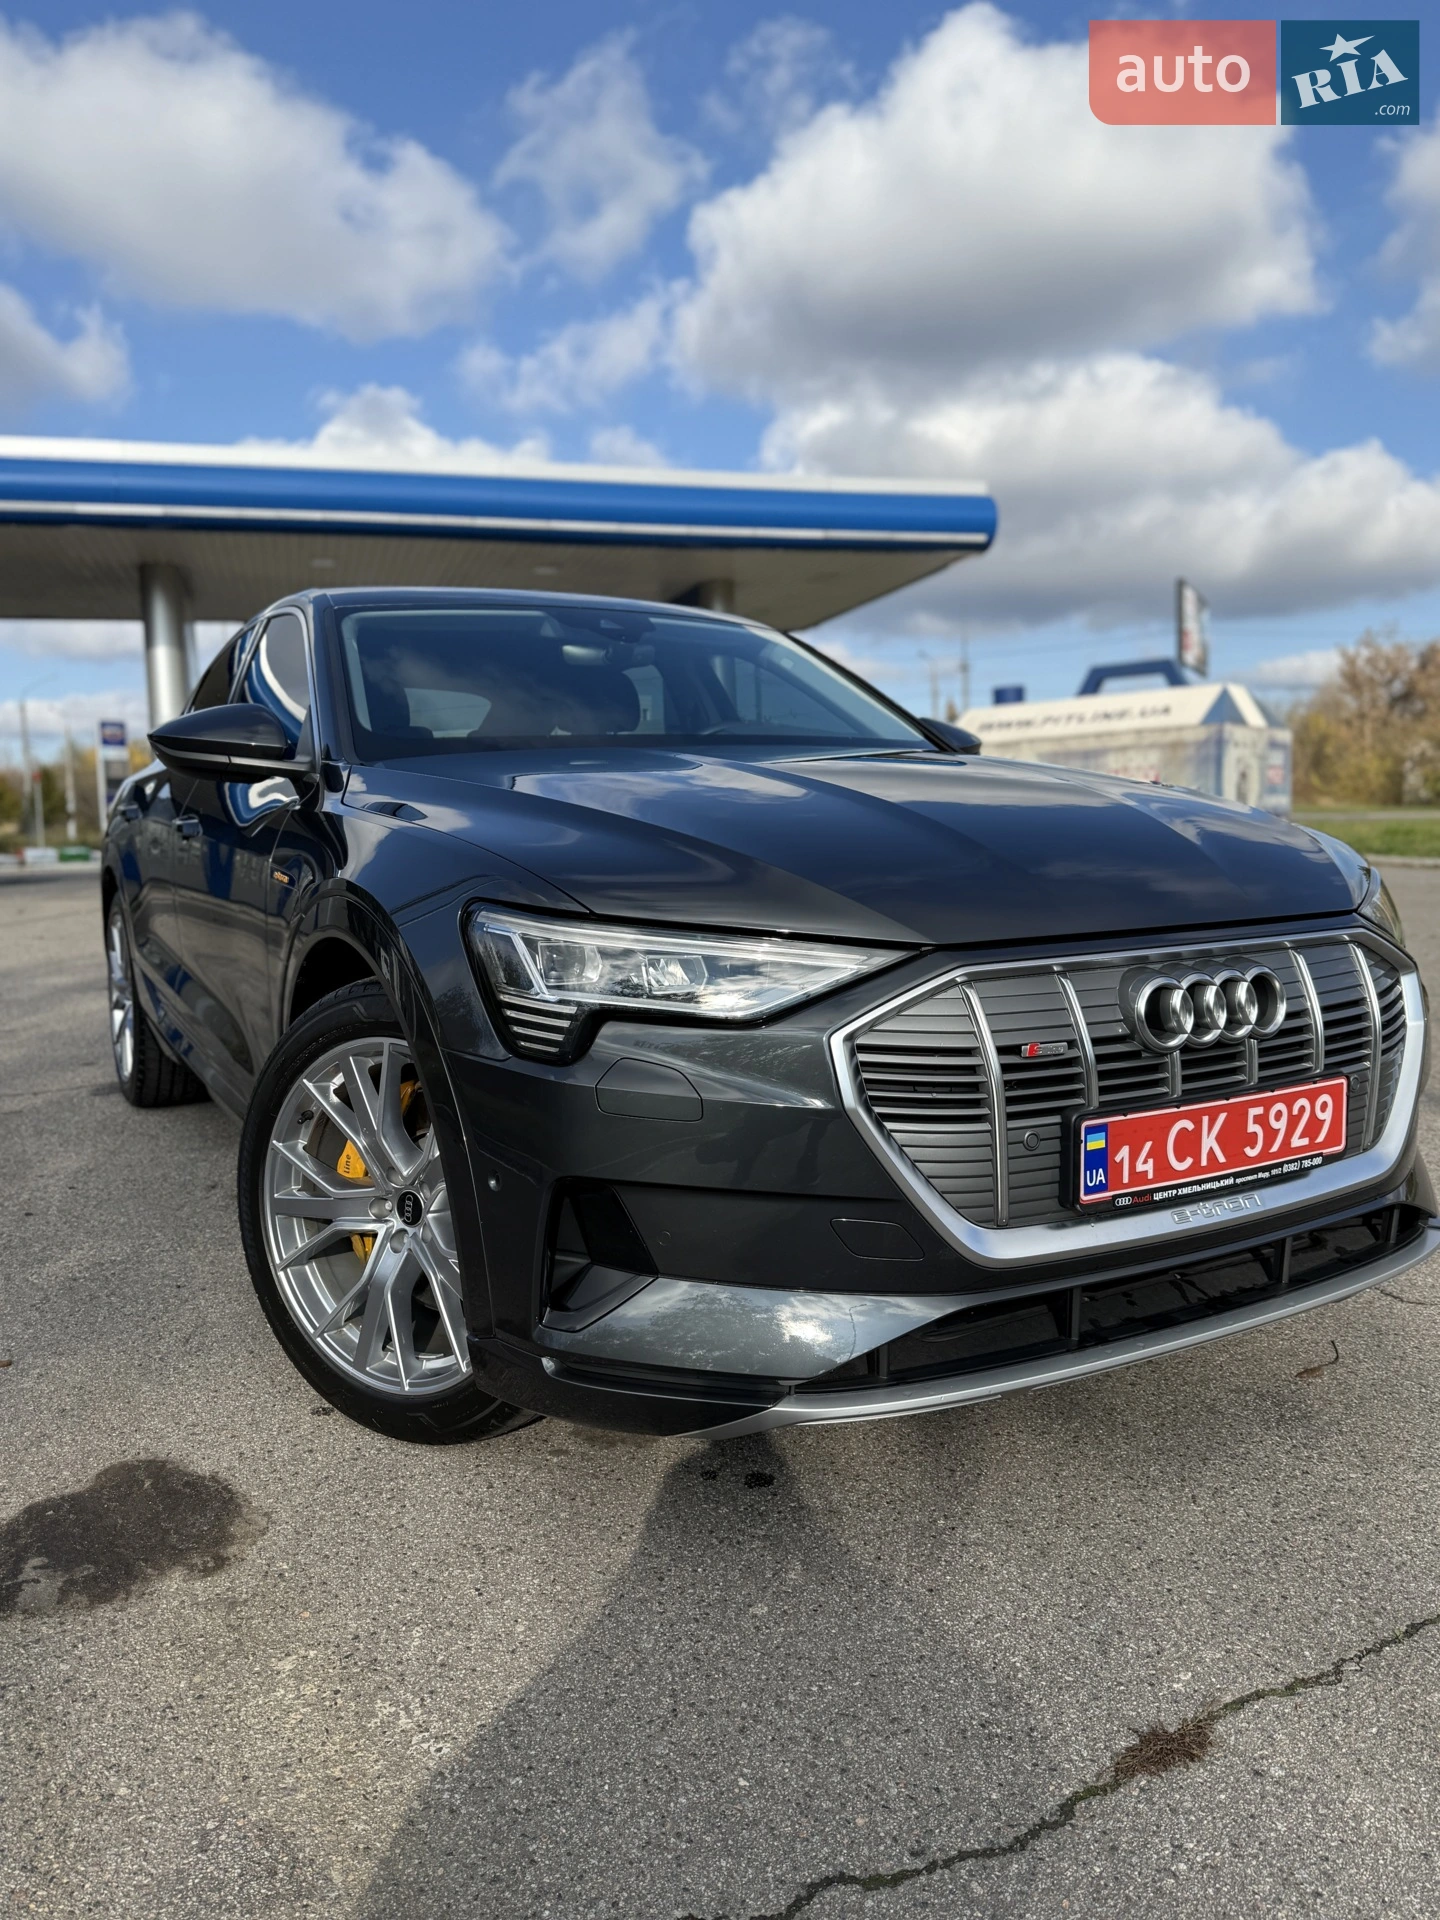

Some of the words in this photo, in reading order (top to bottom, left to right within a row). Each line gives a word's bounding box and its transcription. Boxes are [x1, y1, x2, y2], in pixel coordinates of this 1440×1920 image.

[1114, 1140, 1154, 1184] 14
[1166, 1112, 1228, 1171] CK
[1243, 1093, 1333, 1158] 5929
[1086, 1167, 1106, 1187] UA
[1132, 1193, 1152, 1204] Audi
[1153, 1188, 1178, 1201] ЦЕНТР
[1177, 1177, 1234, 1195] ХМЕЛЬНИЦЬКИЙ
[1171, 1193, 1262, 1225] e-tron
